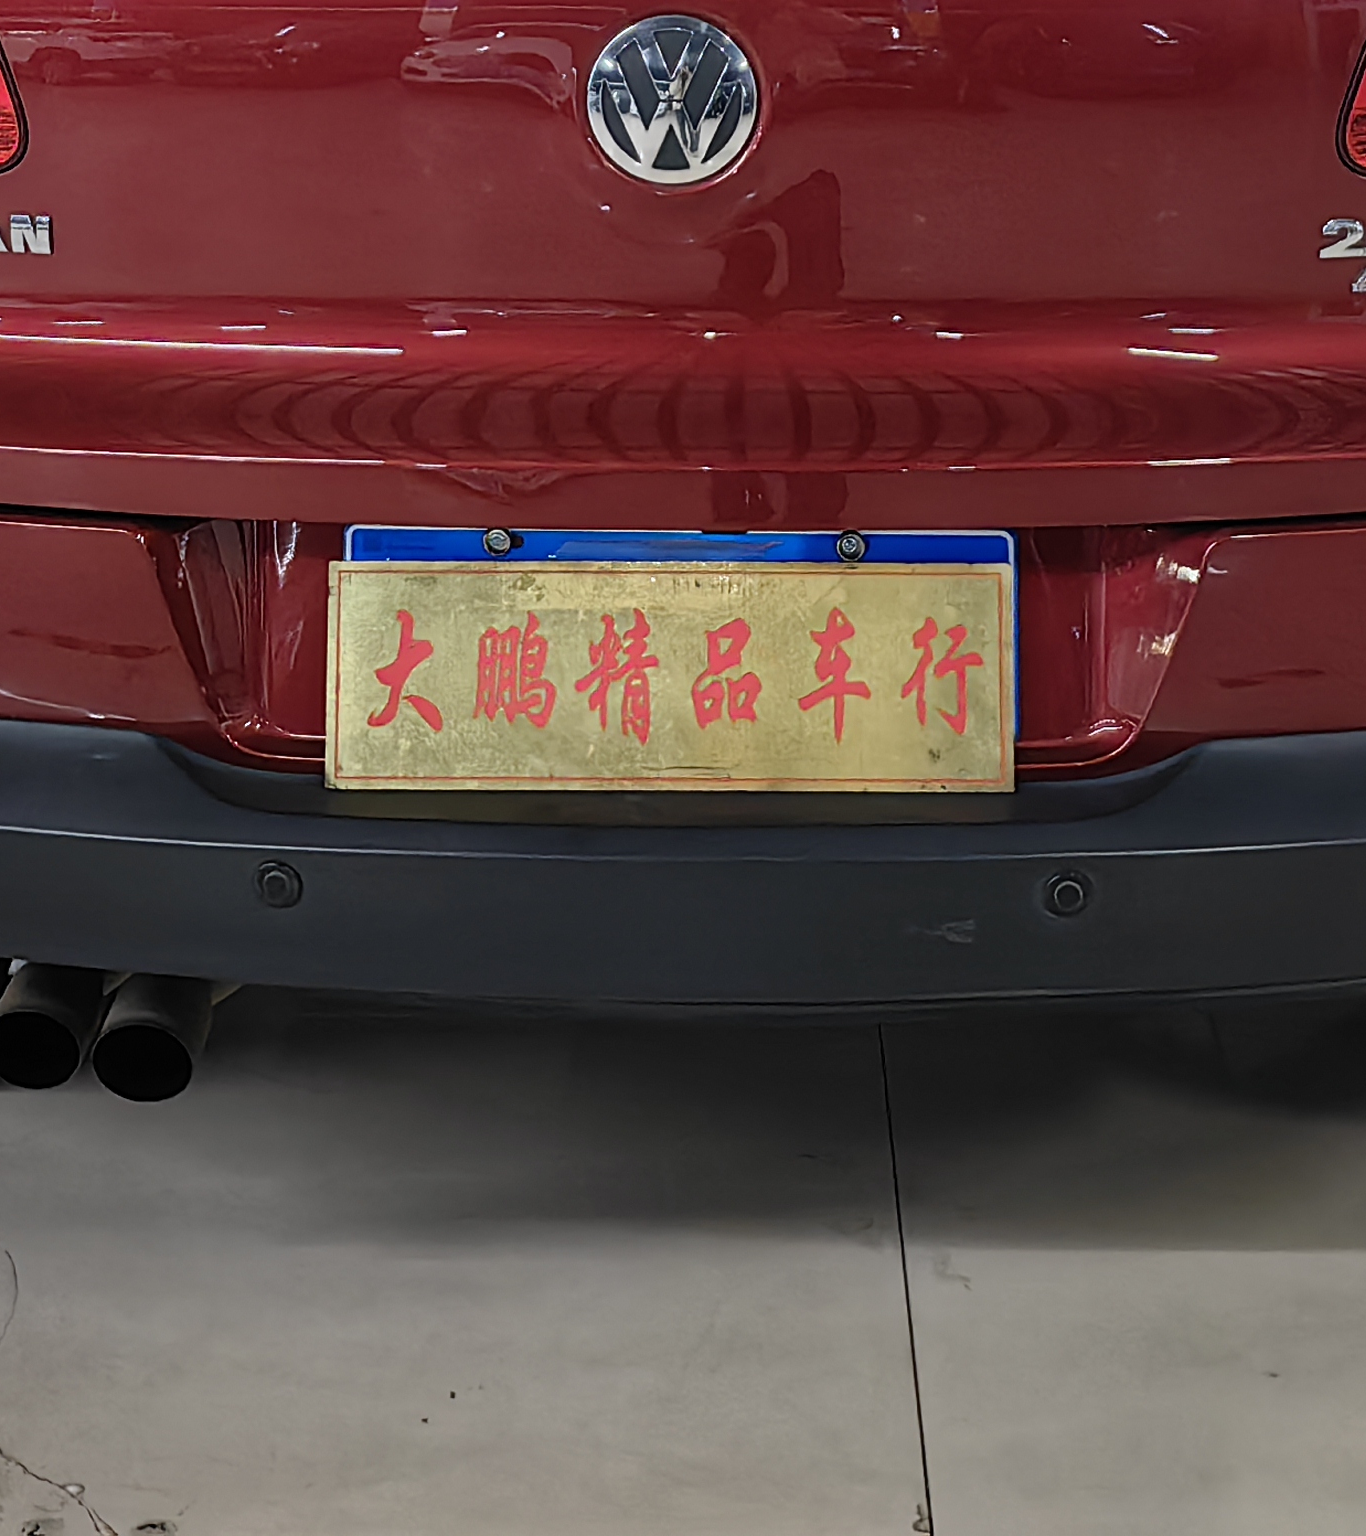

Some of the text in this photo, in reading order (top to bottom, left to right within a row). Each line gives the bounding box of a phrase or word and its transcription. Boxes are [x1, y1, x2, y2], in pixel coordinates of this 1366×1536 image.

[367, 607, 984, 745] 大鹏精品车行
